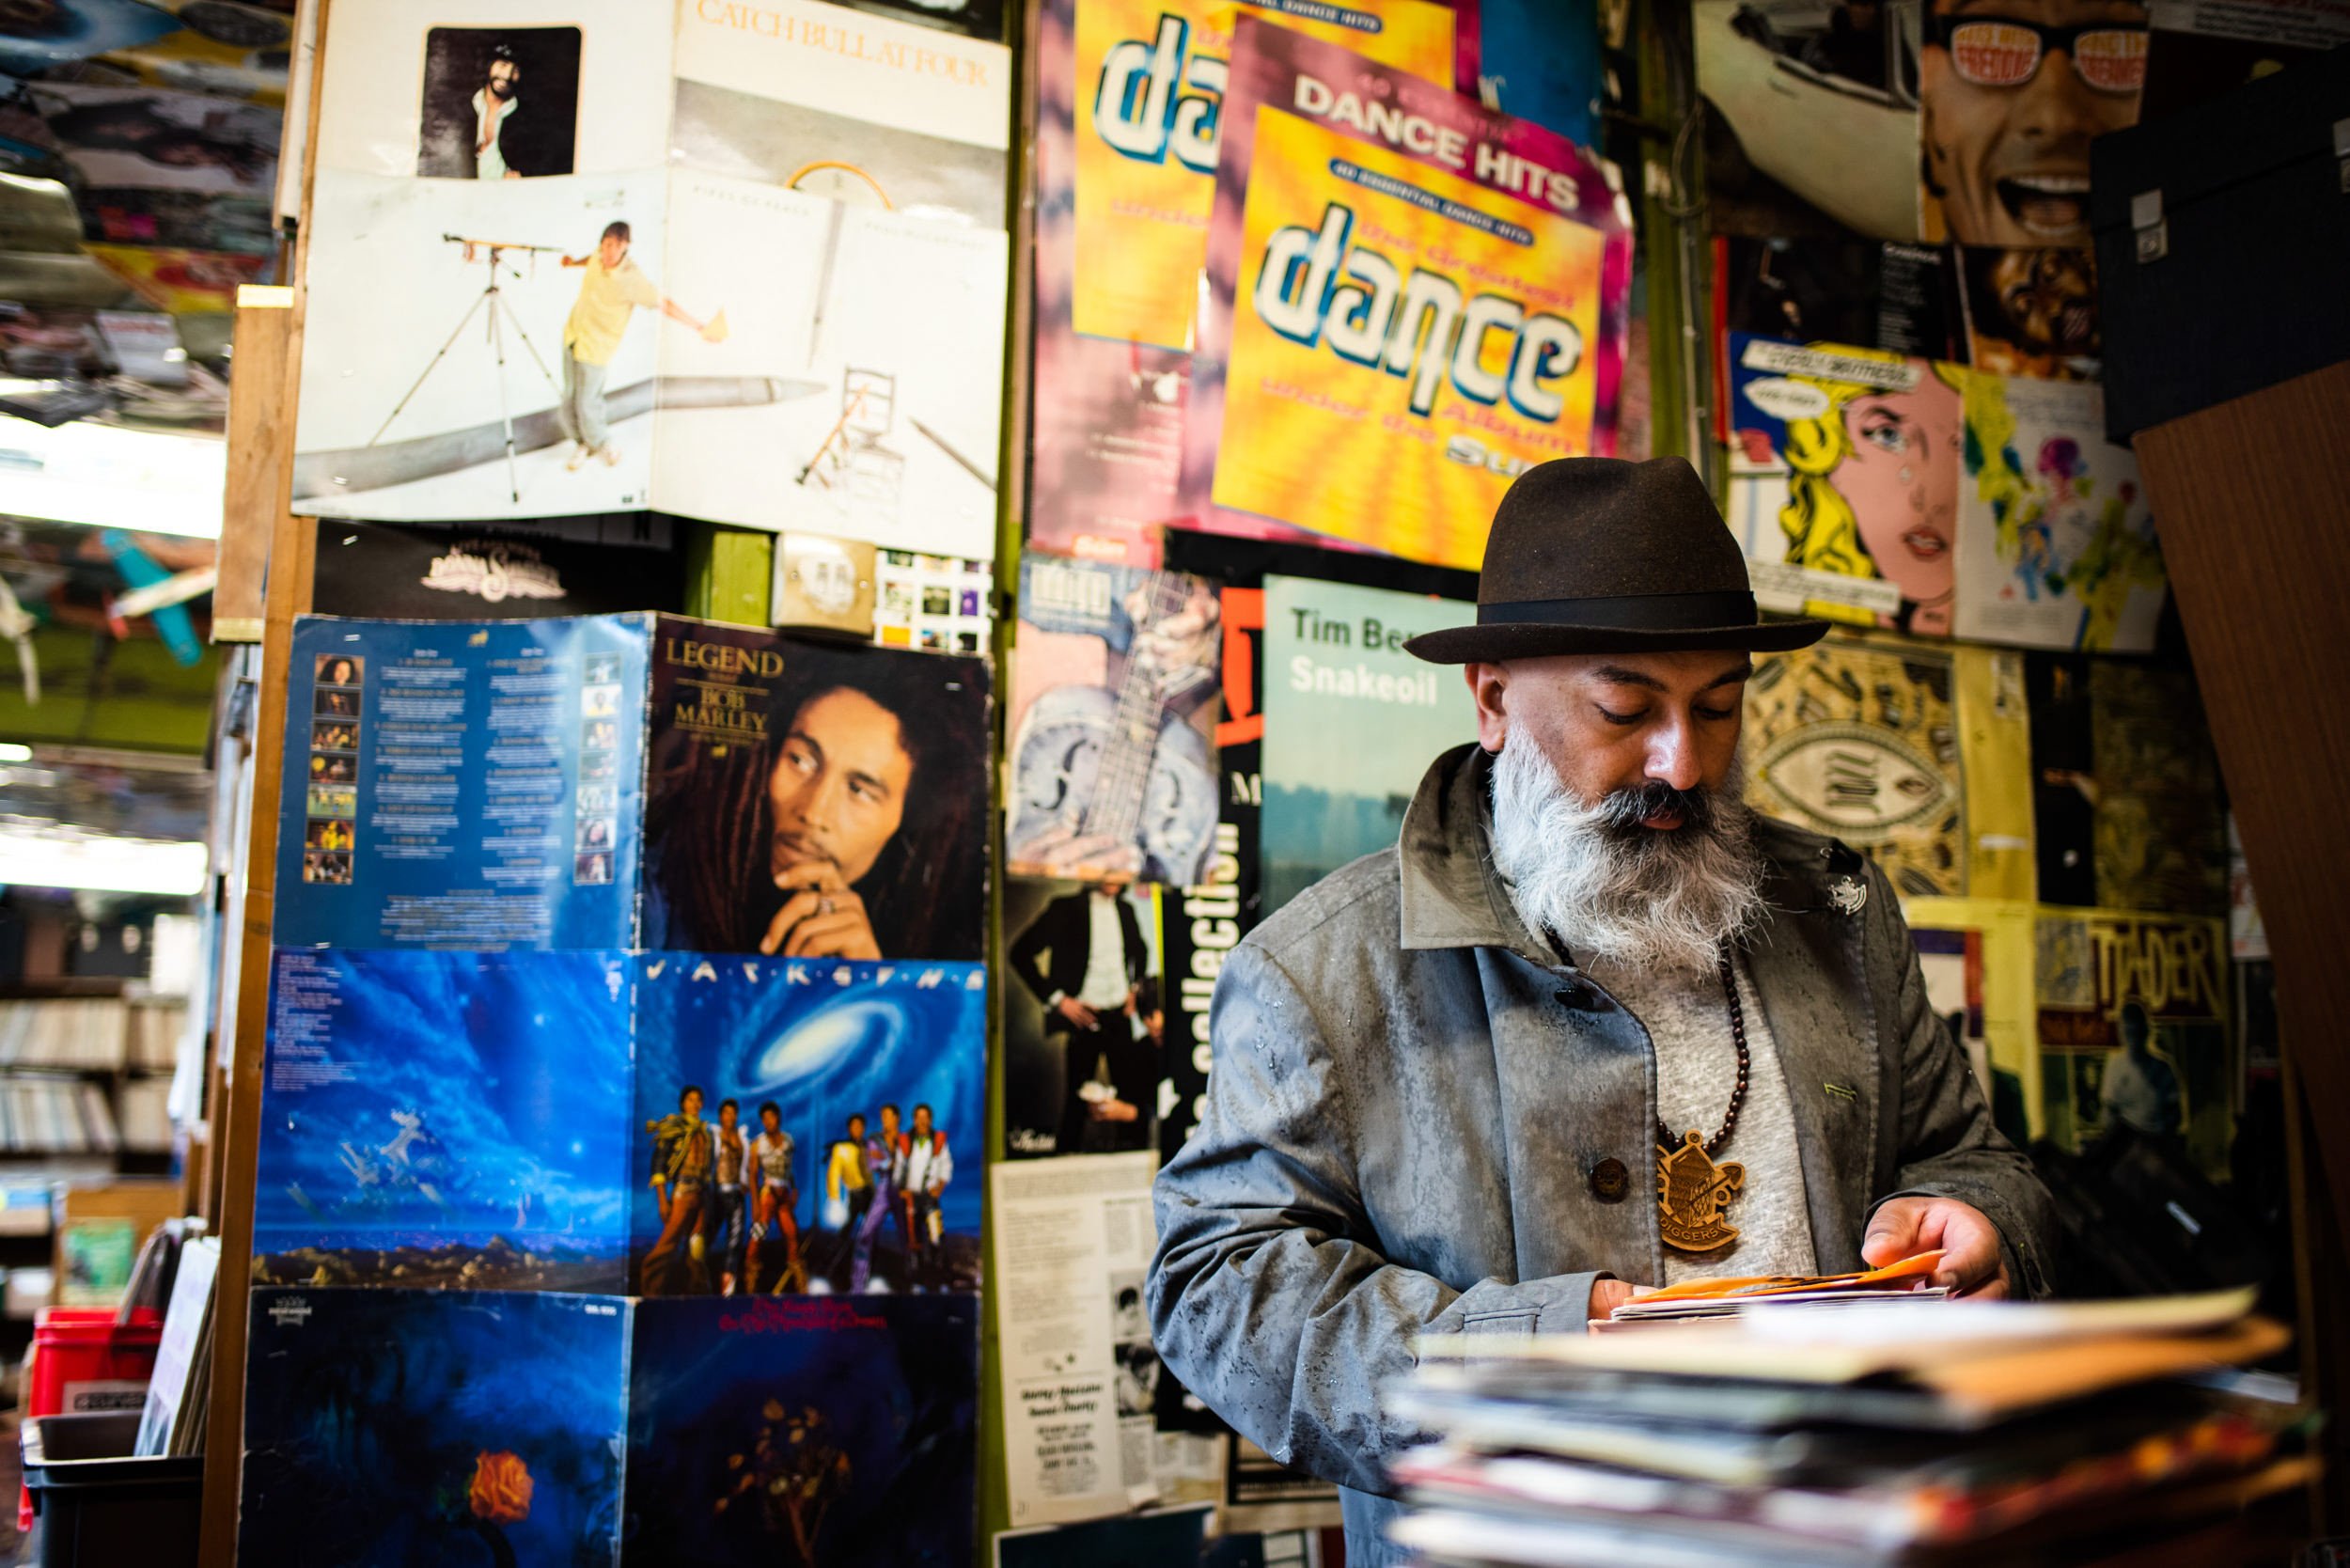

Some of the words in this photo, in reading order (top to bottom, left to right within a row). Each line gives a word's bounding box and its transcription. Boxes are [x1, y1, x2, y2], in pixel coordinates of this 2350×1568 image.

[697, 0, 794, 40] CATCH
[802, 21, 872, 60] BULL
[876, 39, 910, 69] AT
[915, 48, 989, 86] FOUR
[1293, 73, 1467, 169] DANCE
[1474, 143, 1580, 212] HITS
[1253, 201, 1584, 423] dance
[1261, 377, 1370, 422] under
[1446, 434, 1539, 479] Su
[1443, 401, 1575, 454] Album
[1291, 607, 1352, 645] Tim
[666, 637, 785, 679] LEGEND
[1289, 656, 1438, 706] Snakeoil
[676, 702, 769, 733] MARLEY
[700, 688, 747, 712] BOB
[1660, 1216, 1719, 1241] DIGGERS
